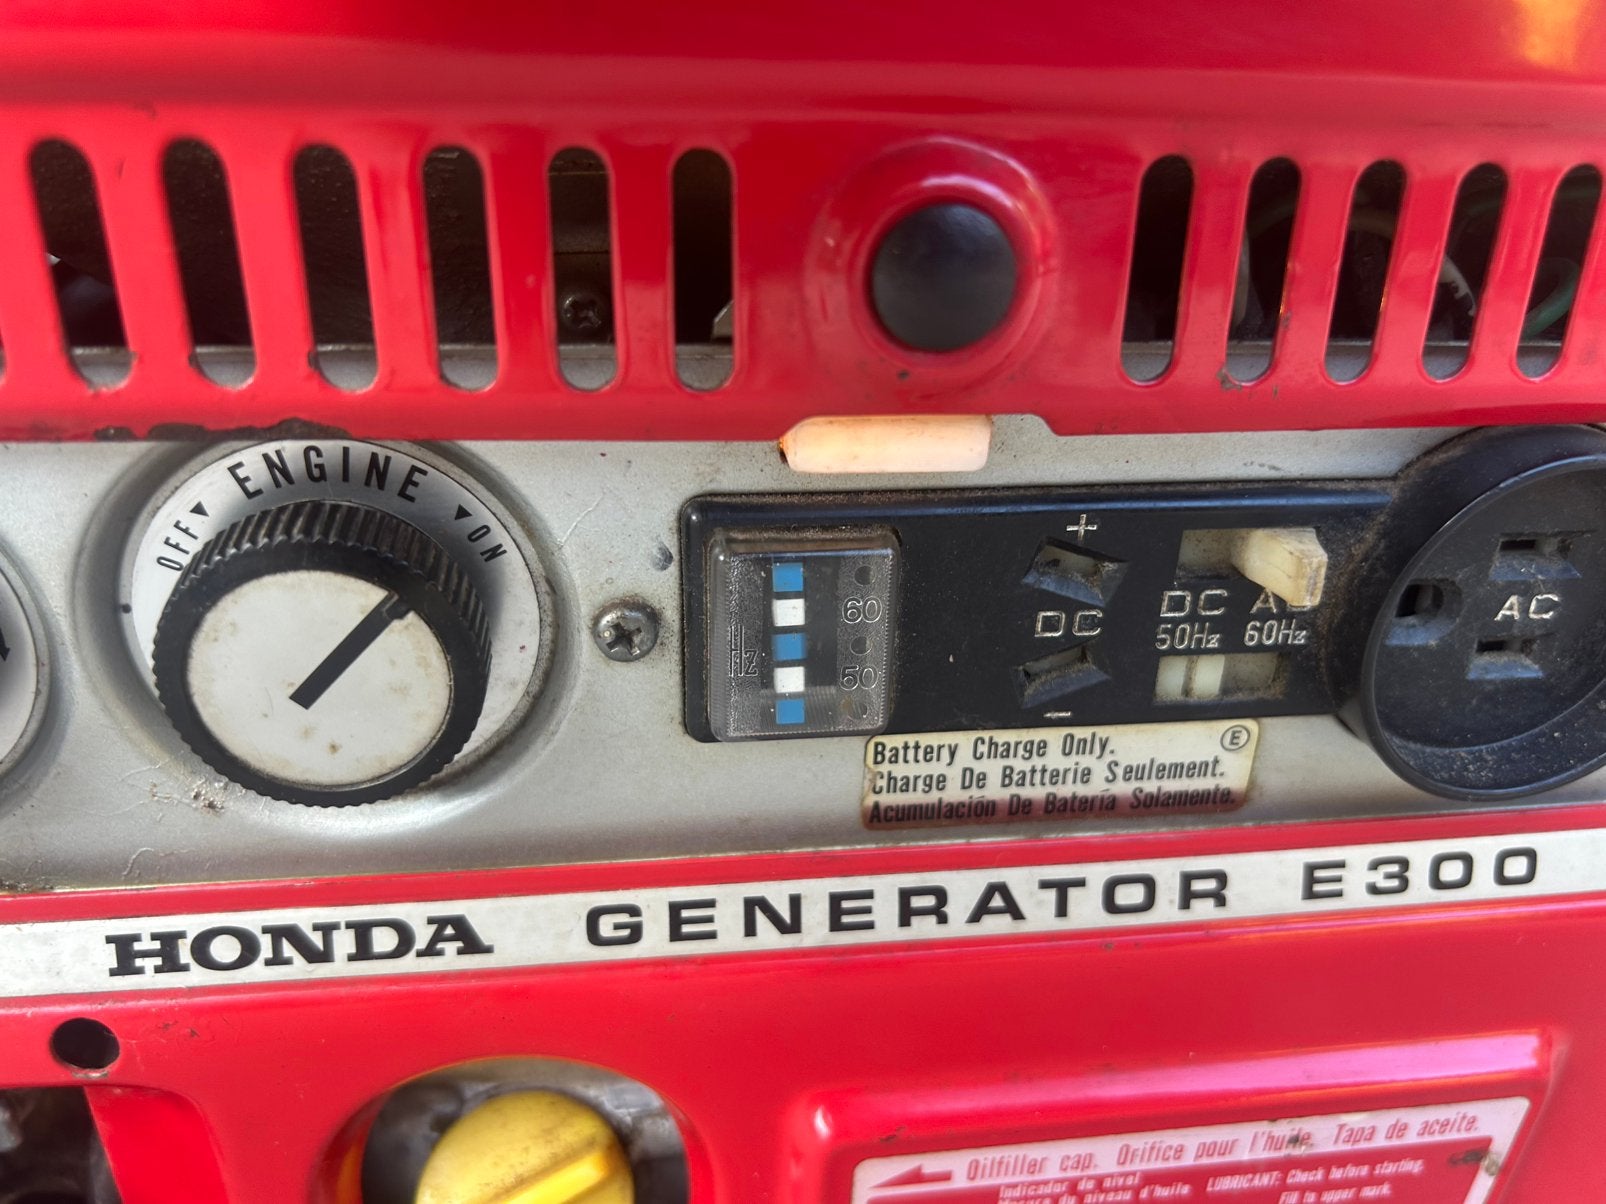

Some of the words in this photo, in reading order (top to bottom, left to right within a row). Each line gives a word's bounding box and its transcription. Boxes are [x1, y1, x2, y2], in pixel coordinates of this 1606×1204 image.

[227, 445, 429, 503] ENGINE
[156, 519, 199, 571] OFF
[467, 524, 508, 563] ON
[841, 596, 883, 624] 60
[1160, 589, 1228, 617] DC
[1249, 588, 1311, 614] A
[1494, 594, 1561, 622] AC
[1034, 609, 1103, 638] DC
[1155, 622, 1221, 650] 50Hz
[1243, 619, 1309, 647] 60Hz
[727, 625, 759, 677] Hz
[839, 665, 879, 691] 50
[872, 736, 959, 766] Battery
[971, 734, 1048, 761] Charge
[1060, 731, 1116, 760] Only.
[872, 769, 947, 795] Charge
[960, 768, 988, 790] De
[1000, 762, 1092, 787] Batterie
[1103, 755, 1226, 784] Seulement.
[868, 795, 996, 824] Acumulación
[1007, 793, 1033, 816] De
[1043, 788, 1117, 814] Batería
[1129, 784, 1236, 810] Solamente.
[105, 913, 495, 977] HONDA
[586, 868, 1228, 947] GENERATOR
[1301, 846, 1538, 901] E300
[966, 1157, 1046, 1181] Oilfiller
[1060, 1152, 1098, 1172] cap.
[1116, 1141, 1185, 1166] Orifice
[1193, 1137, 1240, 1163] pour
[1333, 1123, 1377, 1146] Tapa
[1384, 1120, 1409, 1141] de
[1416, 1111, 1479, 1137] aceite.
[999, 1178, 1069, 1199] Indicador
[1077, 1176, 1097, 1192] de
[1102, 1171, 1142, 1188] nivel
[1206, 1170, 1283, 1193] LUBRICANT:
[1285, 1165, 1325, 1185] Check
[1328, 1160, 1370, 1180] before
[1373, 1157, 1425, 1175] starting.
[1320, 1185, 1356, 1203] upper
[1358, 1181, 1393, 1198] mark.
[1083, 1188, 1134, 1204] niveau
[1138, 1182, 1193, 1200] d'huile
